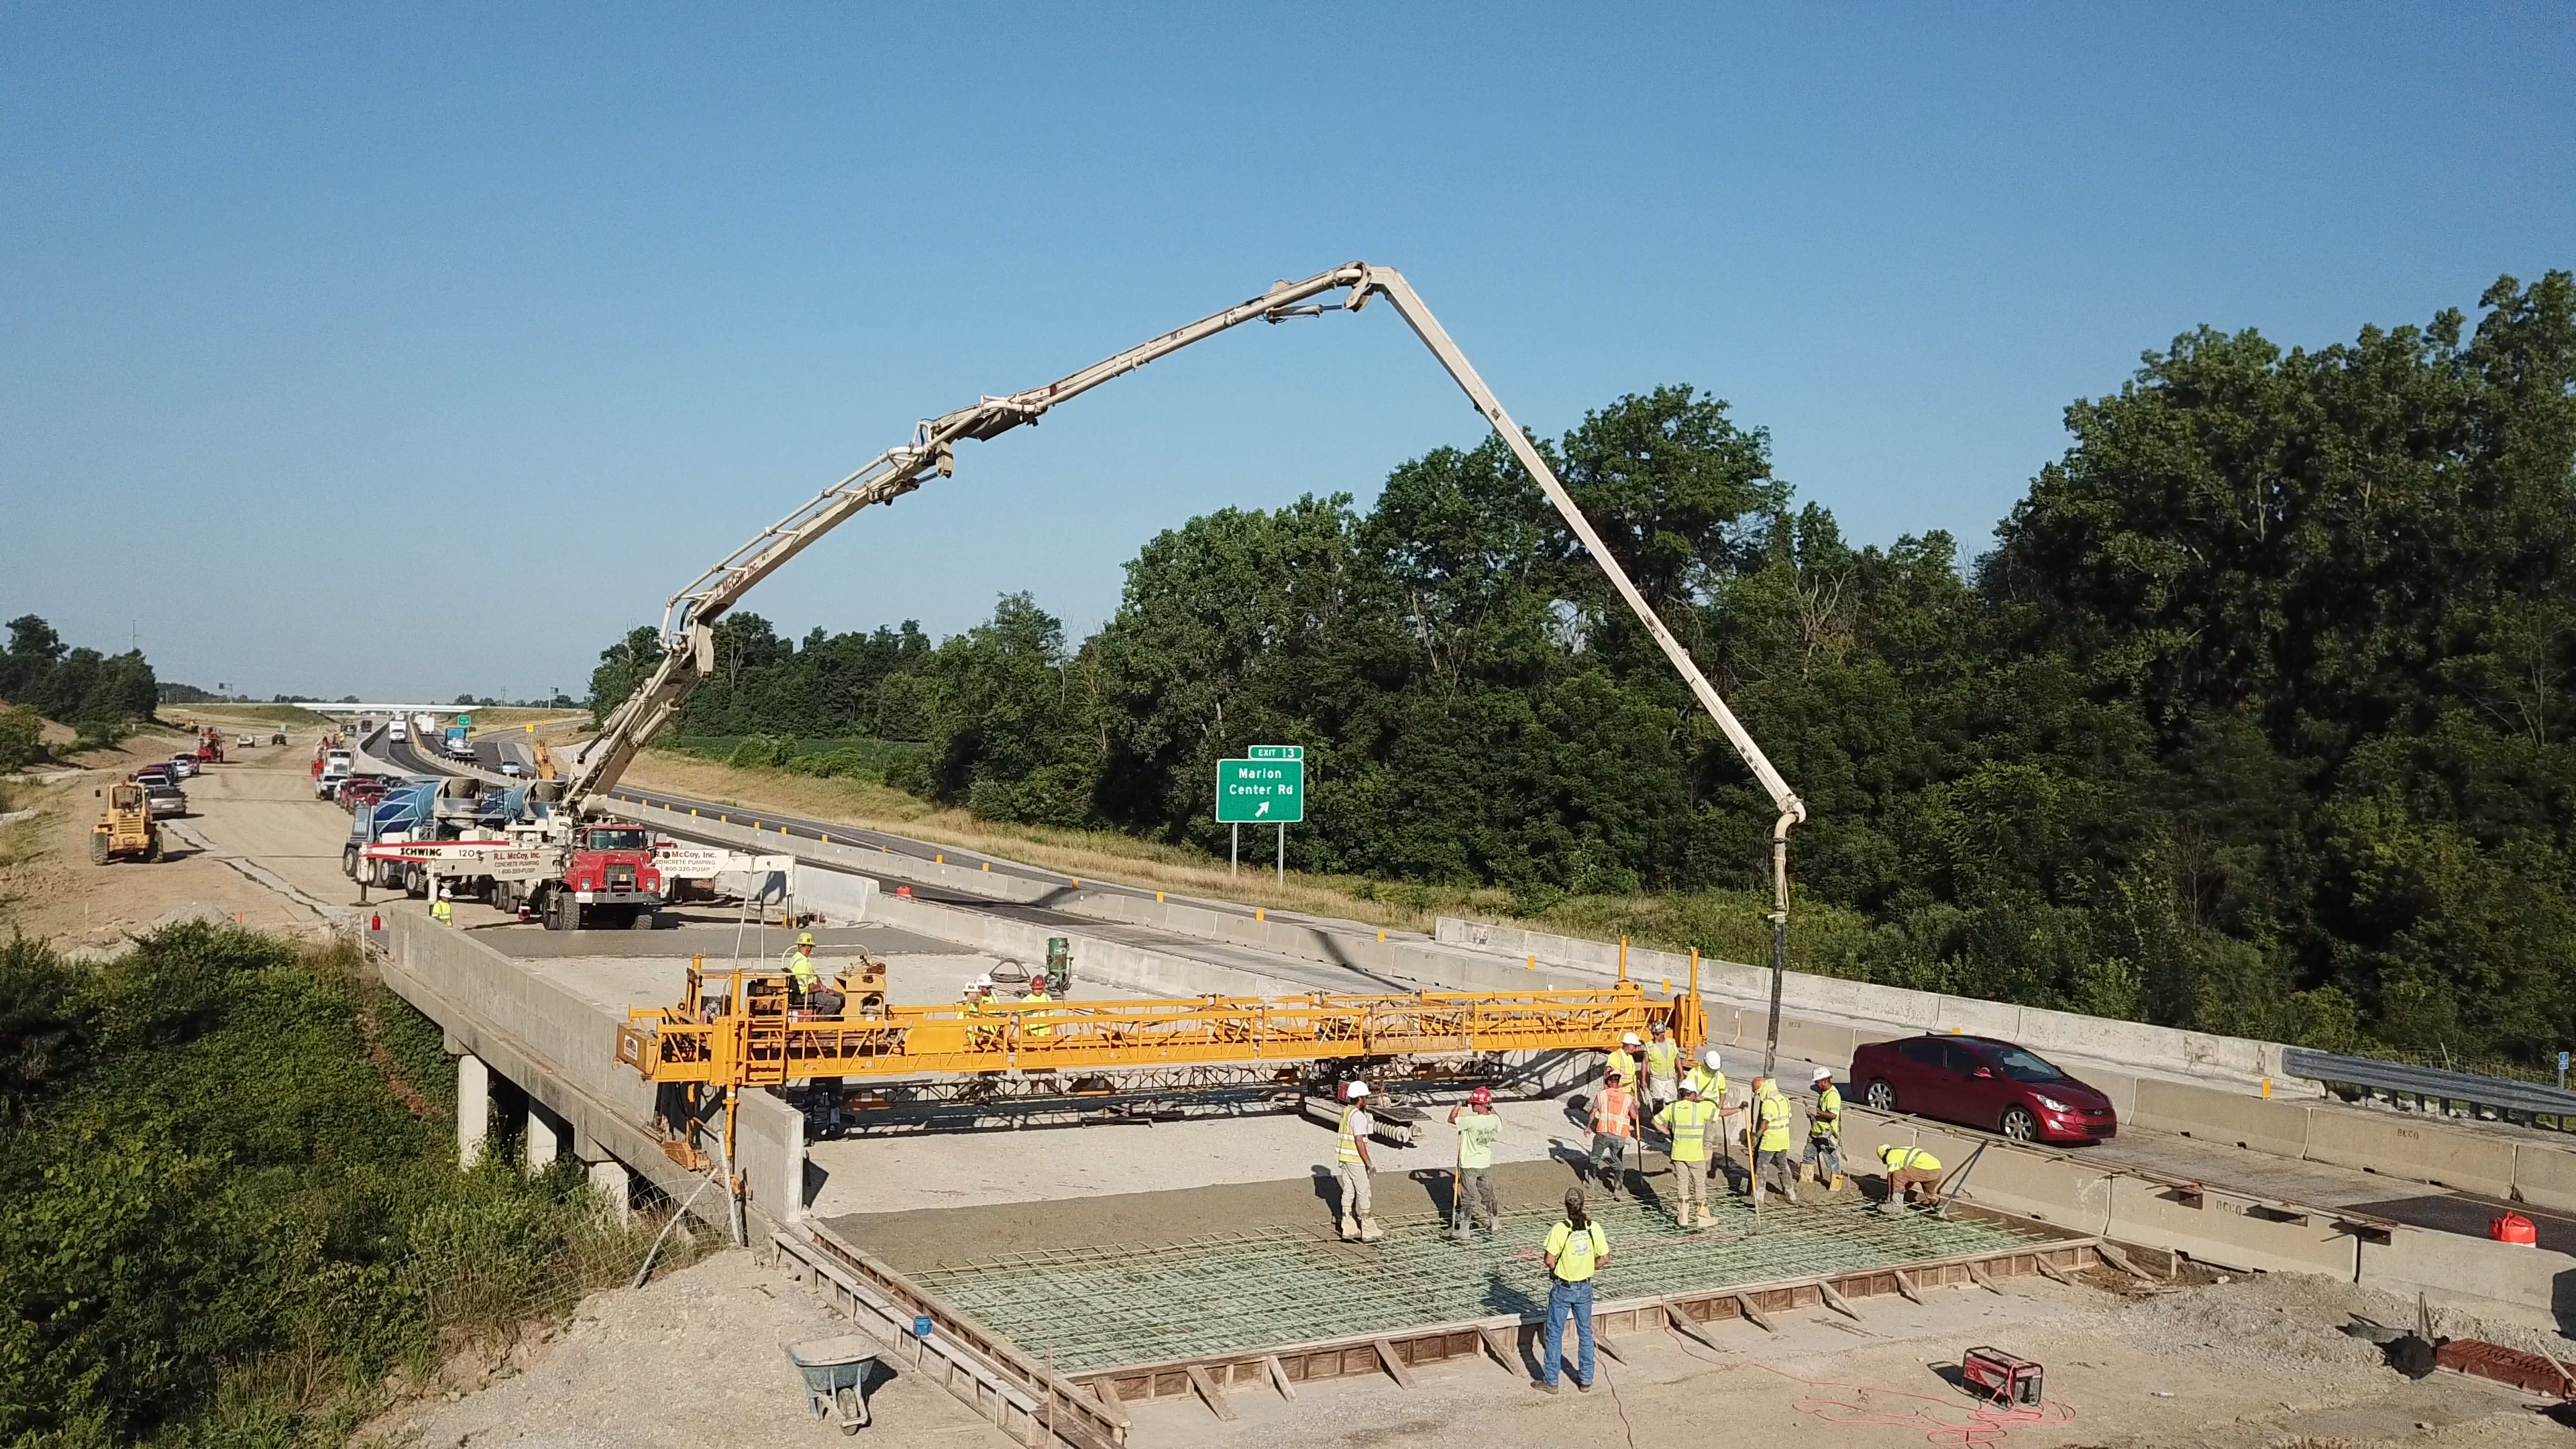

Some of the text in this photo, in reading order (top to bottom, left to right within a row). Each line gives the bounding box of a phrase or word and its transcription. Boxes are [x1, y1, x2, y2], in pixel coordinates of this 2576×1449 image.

[747, 562, 759, 576] Inc.
[1258, 748, 1295, 758] EXIT 13
[1238, 767, 1282, 779] Marion
[1229, 784, 1293, 795] Center Rd
[400, 847, 442, 857] SCHWING
[507, 852, 529, 860] McCoy,
[672, 851, 700, 859] McCoy,
